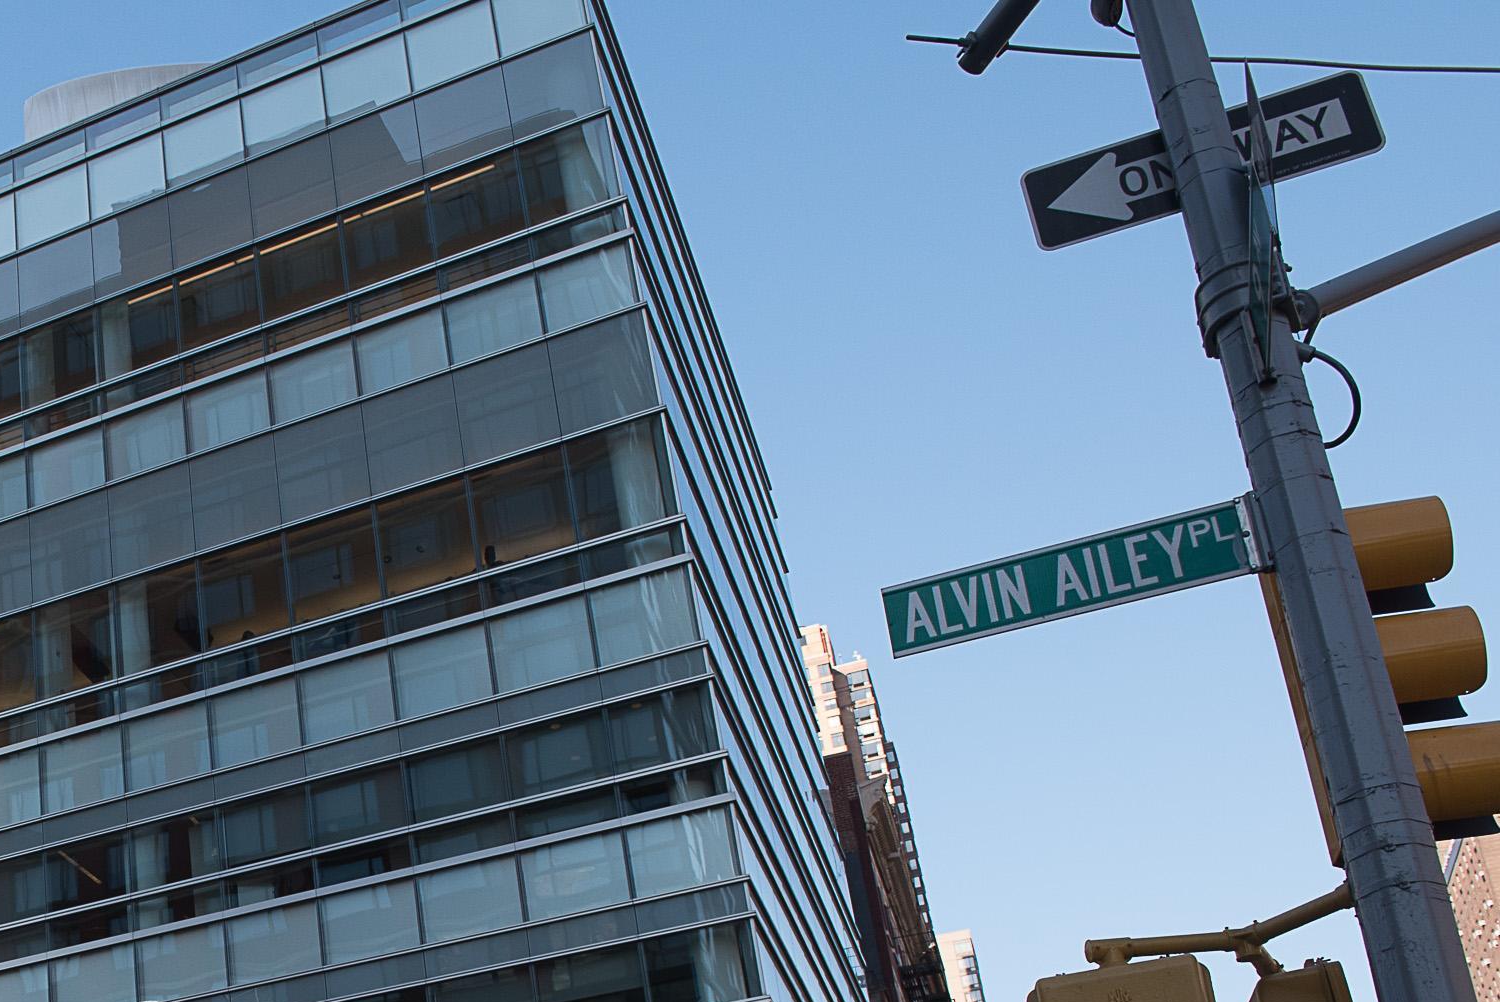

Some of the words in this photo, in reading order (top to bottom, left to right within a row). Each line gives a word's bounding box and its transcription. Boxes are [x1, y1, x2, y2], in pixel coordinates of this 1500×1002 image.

[1118, 158, 1176, 197] ON
[906, 565, 1032, 643] ALVIN
[1056, 524, 1184, 606] AILEY
[1187, 516, 1236, 548] PL
